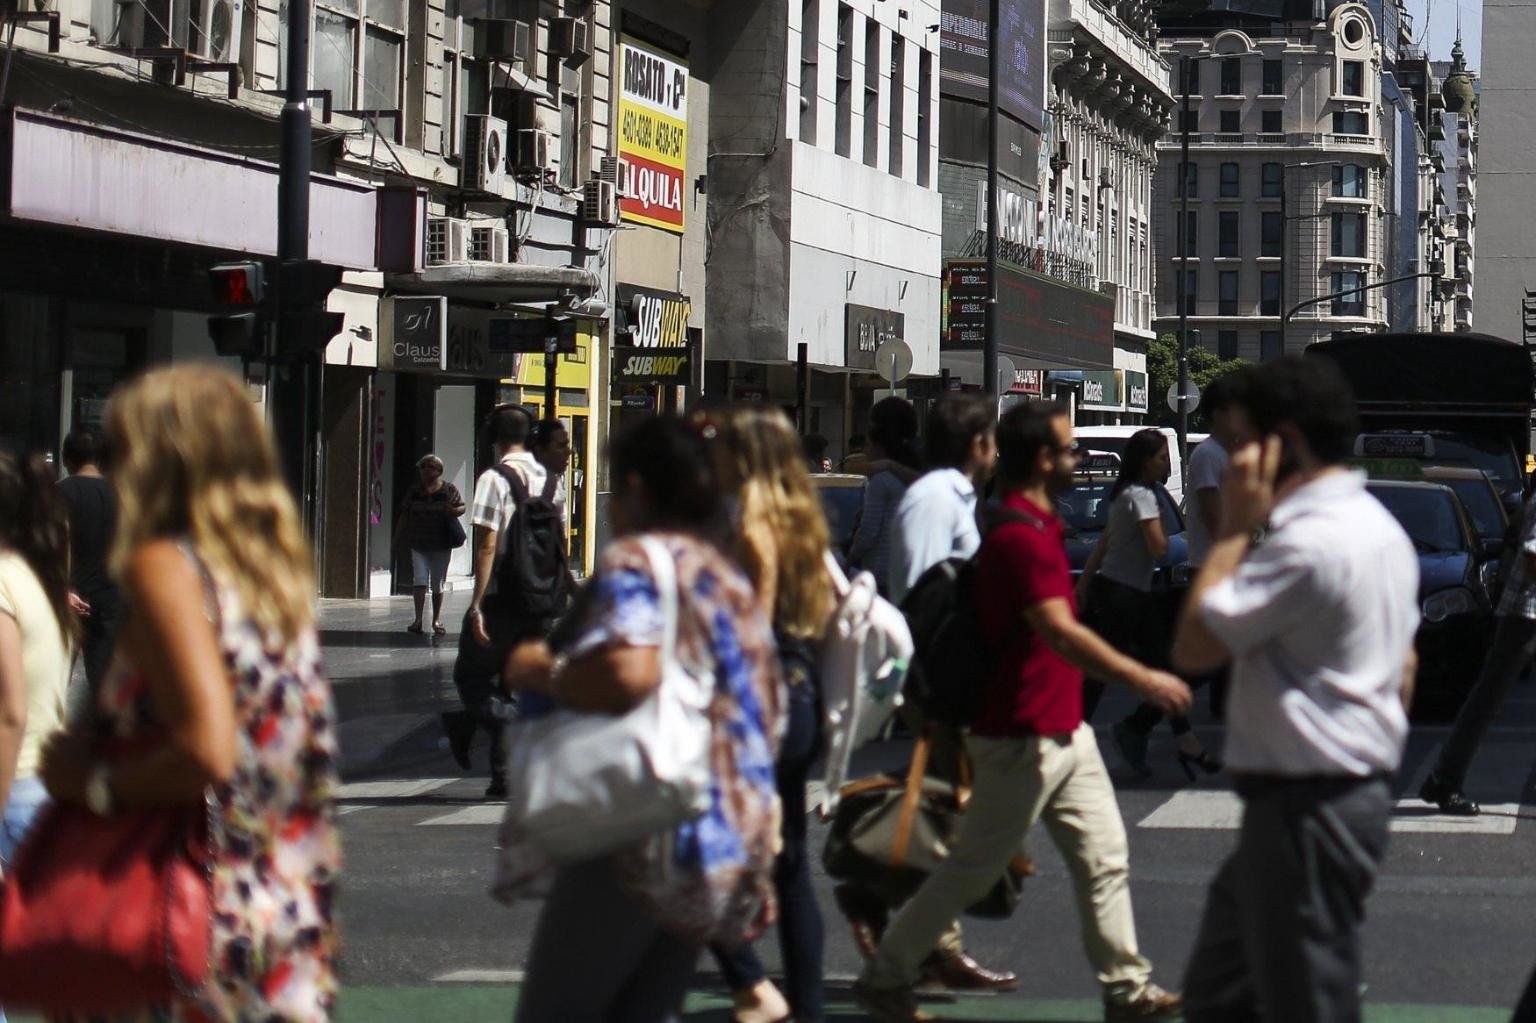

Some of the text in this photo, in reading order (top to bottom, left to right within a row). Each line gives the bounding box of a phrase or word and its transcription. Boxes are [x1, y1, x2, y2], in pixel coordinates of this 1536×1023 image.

[624, 48, 664, 105] ROSATO
[629, 295, 691, 348] SUBWAY
[394, 342, 441, 356] Claus
[623, 356, 687, 376] SUBWAY
